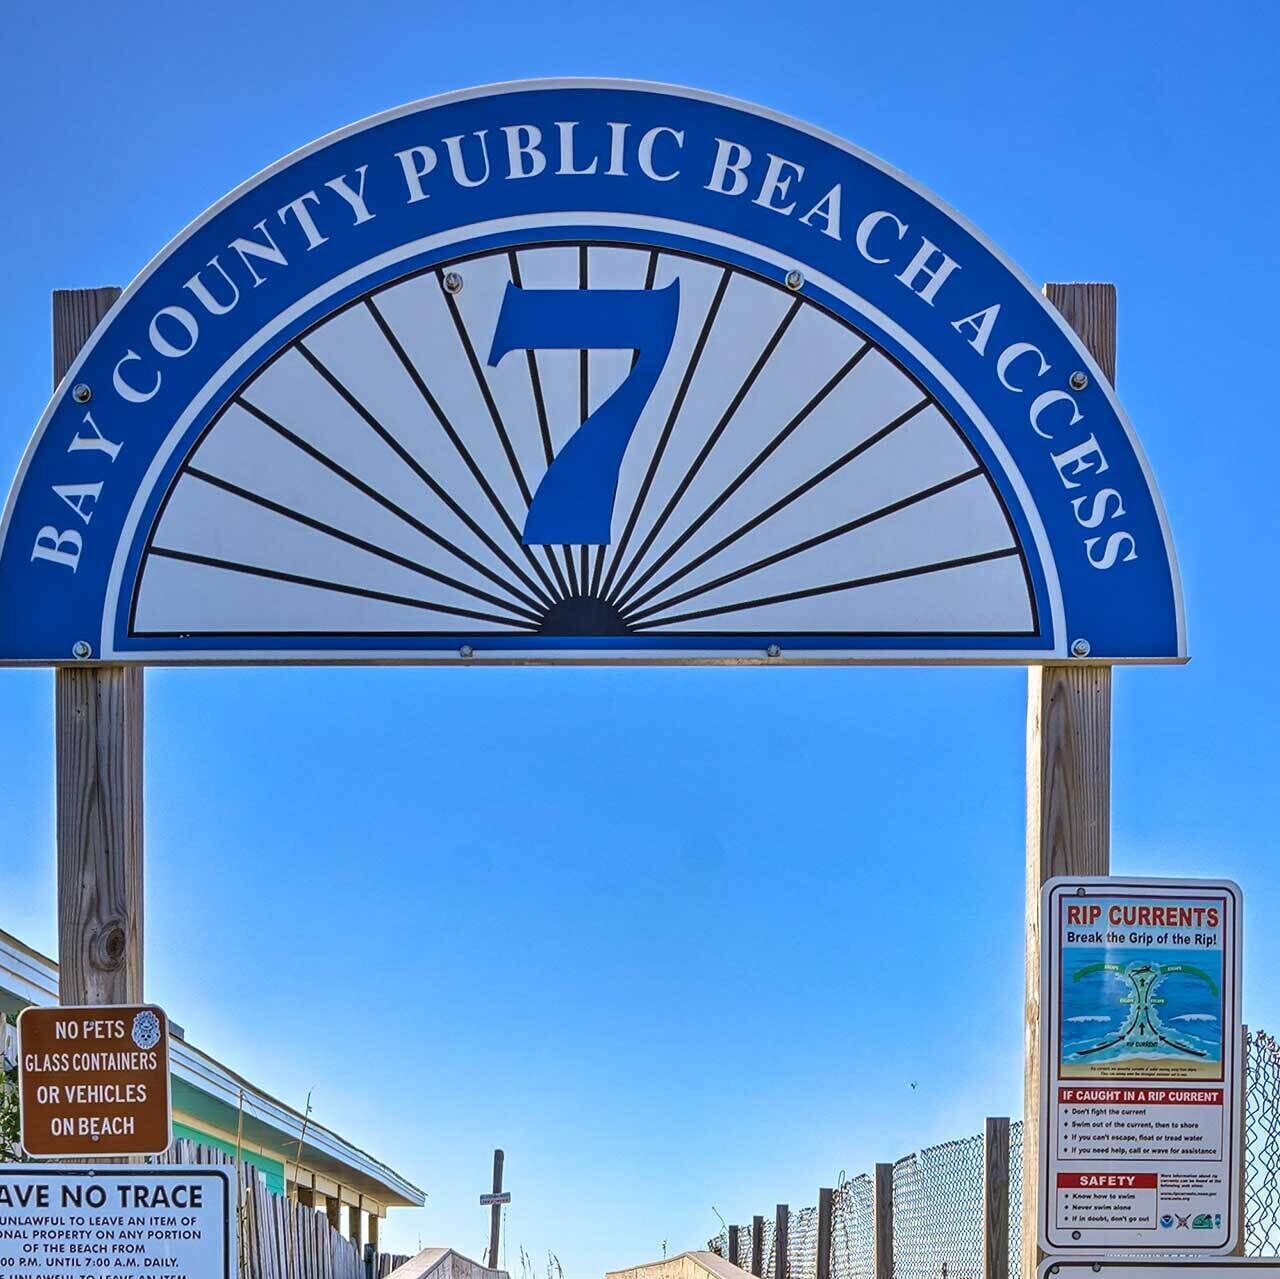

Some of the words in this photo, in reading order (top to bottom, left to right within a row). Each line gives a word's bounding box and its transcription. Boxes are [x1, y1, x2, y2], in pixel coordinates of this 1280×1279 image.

[30, 411, 124, 574] BAY
[112, 165, 376, 404] COUNTY
[394, 121, 685, 204] PUBLIC
[703, 136, 962, 307] BEACH
[950, 303, 1138, 571] ACCESS
[487, 276, 680, 545] 7
[1067, 905, 1101, 924] RIP
[1108, 906, 1218, 928] CURRENTS
[1067, 931, 1102, 943] Break
[1106, 931, 1125, 943] the
[1129, 932, 1153, 945] Grip
[1156, 932, 1168, 944] of
[1172, 933, 1190, 944] the
[1194, 933, 1216, 946] Rip!
[55, 1021, 78, 1039] NO
[83, 1020, 124, 1038] PETS
[25, 1053, 69, 1072] GLASS
[72, 1051, 157, 1071] CONTAINERS
[37, 1085, 59, 1103] OR
[64, 1084, 146, 1103] VEHICLES
[1063, 1090, 1073, 1100] IF
[1075, 1090, 1121, 1100] CAUGHT
[1123, 1091, 1134, 1100] IN
[1137, 1091, 1145, 1100] A
[1148, 1091, 1165, 1101] RIP
[1168, 1091, 1218, 1101] CURRENT
[51, 1117, 73, 1135] ON
[78, 1116, 133, 1136] BEACH
[1080, 1175, 1135, 1185] SAFETY
[61, 1184, 106, 1208] NO
[117, 1184, 202, 1208] TRACE
[69, 1216, 85, 1225] TO
[89, 1216, 123, 1225] LEAVE
[127, 1216, 145, 1225] AN
[149, 1216, 176, 1225] ITEM
[180, 1216, 196, 1226] OF
[32, 1229, 92, 1239] PROPERTY
[95, 1230, 114, 1239] ON
[118, 1230, 143, 1239] ANY
[147, 1230, 201, 1239] PORTION
[22, 1243, 38, 1252] OF
[43, 1243, 65, 1253] THE
[69, 1243, 107, 1253] BEACH
[112, 1243, 145, 1253] FROM
[19, 1257, 41, 1266] P.M.
[46, 1257, 81, 1266] UNTIL
[85, 1257, 110, 1267] 7:00
[113, 1257, 139, 1267] A.M.
[144, 1257, 178, 1267] DAILY.
